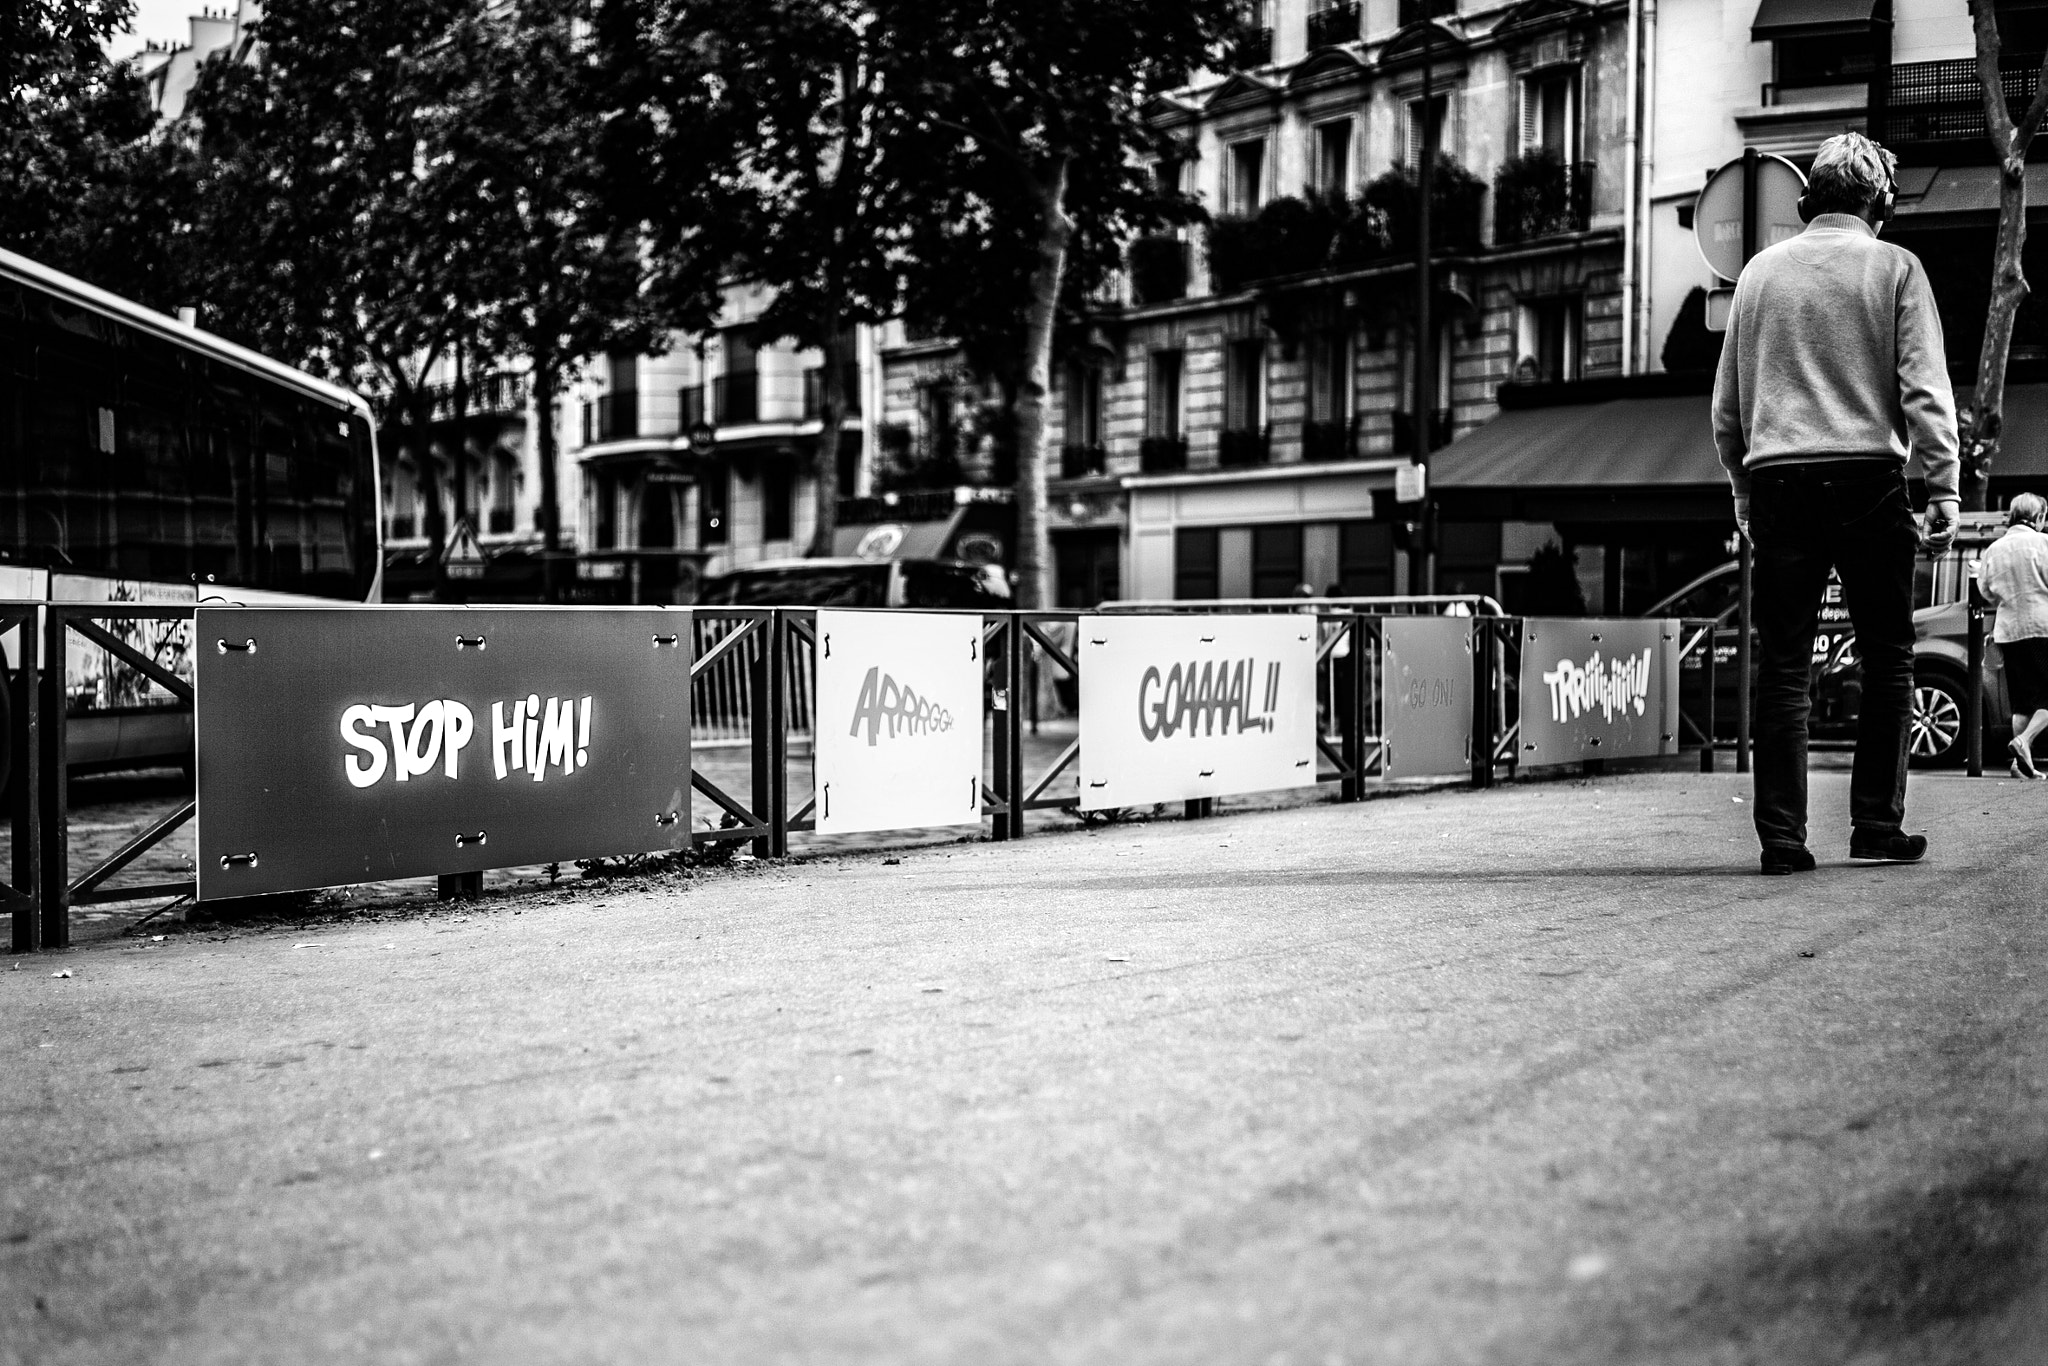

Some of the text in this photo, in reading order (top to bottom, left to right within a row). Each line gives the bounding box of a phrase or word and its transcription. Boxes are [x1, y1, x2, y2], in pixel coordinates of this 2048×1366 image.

[1138, 657, 1280, 742] GOAAAAL!!
[1410, 678, 1455, 709] GO ON!
[340, 699, 474, 788] STOP
